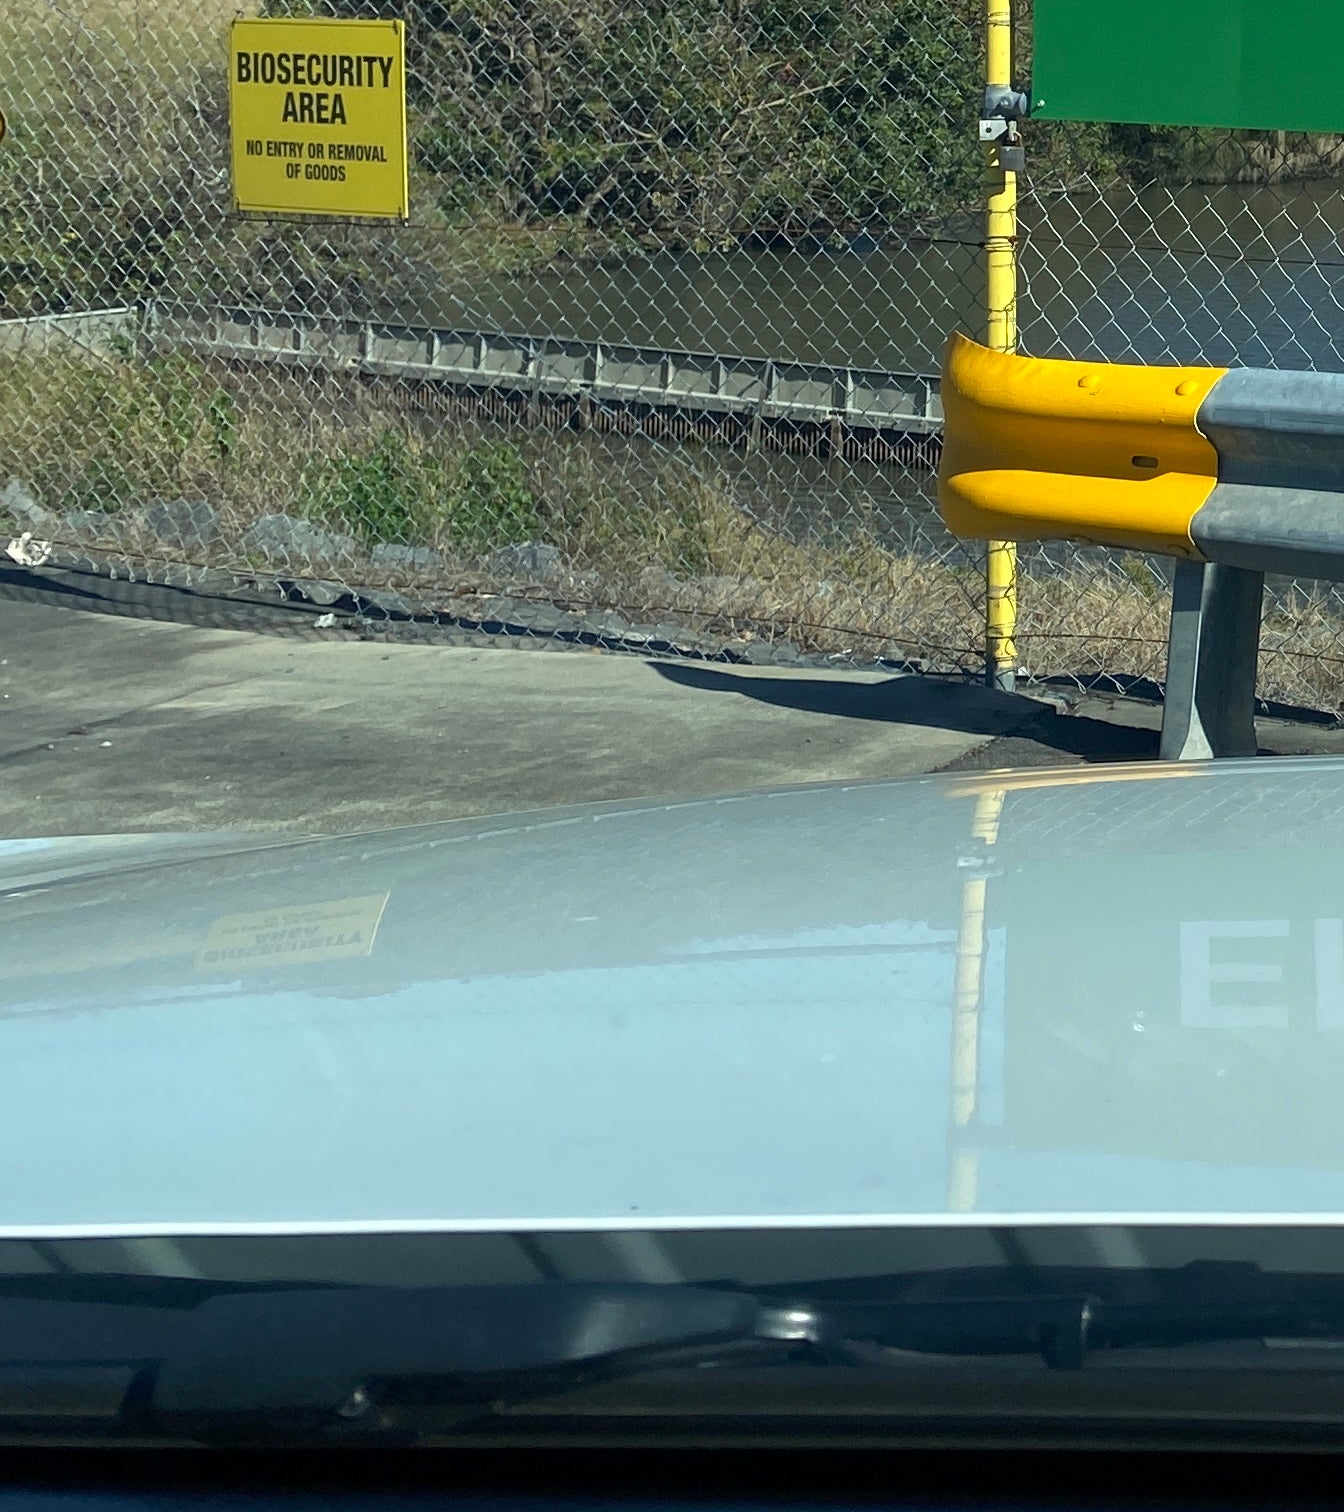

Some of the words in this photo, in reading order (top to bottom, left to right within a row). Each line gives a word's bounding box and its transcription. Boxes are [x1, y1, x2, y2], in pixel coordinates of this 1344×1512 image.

[236, 51, 394, 88] BIOSECURITY
[282, 91, 347, 125] AREA
[245, 140, 263, 156] NO
[266, 140, 304, 159] ENTRY
[307, 143, 325, 160] OR
[328, 145, 388, 163] REMOVAL
[286, 163, 302, 179] OF
[305, 164, 346, 181] GOODS
